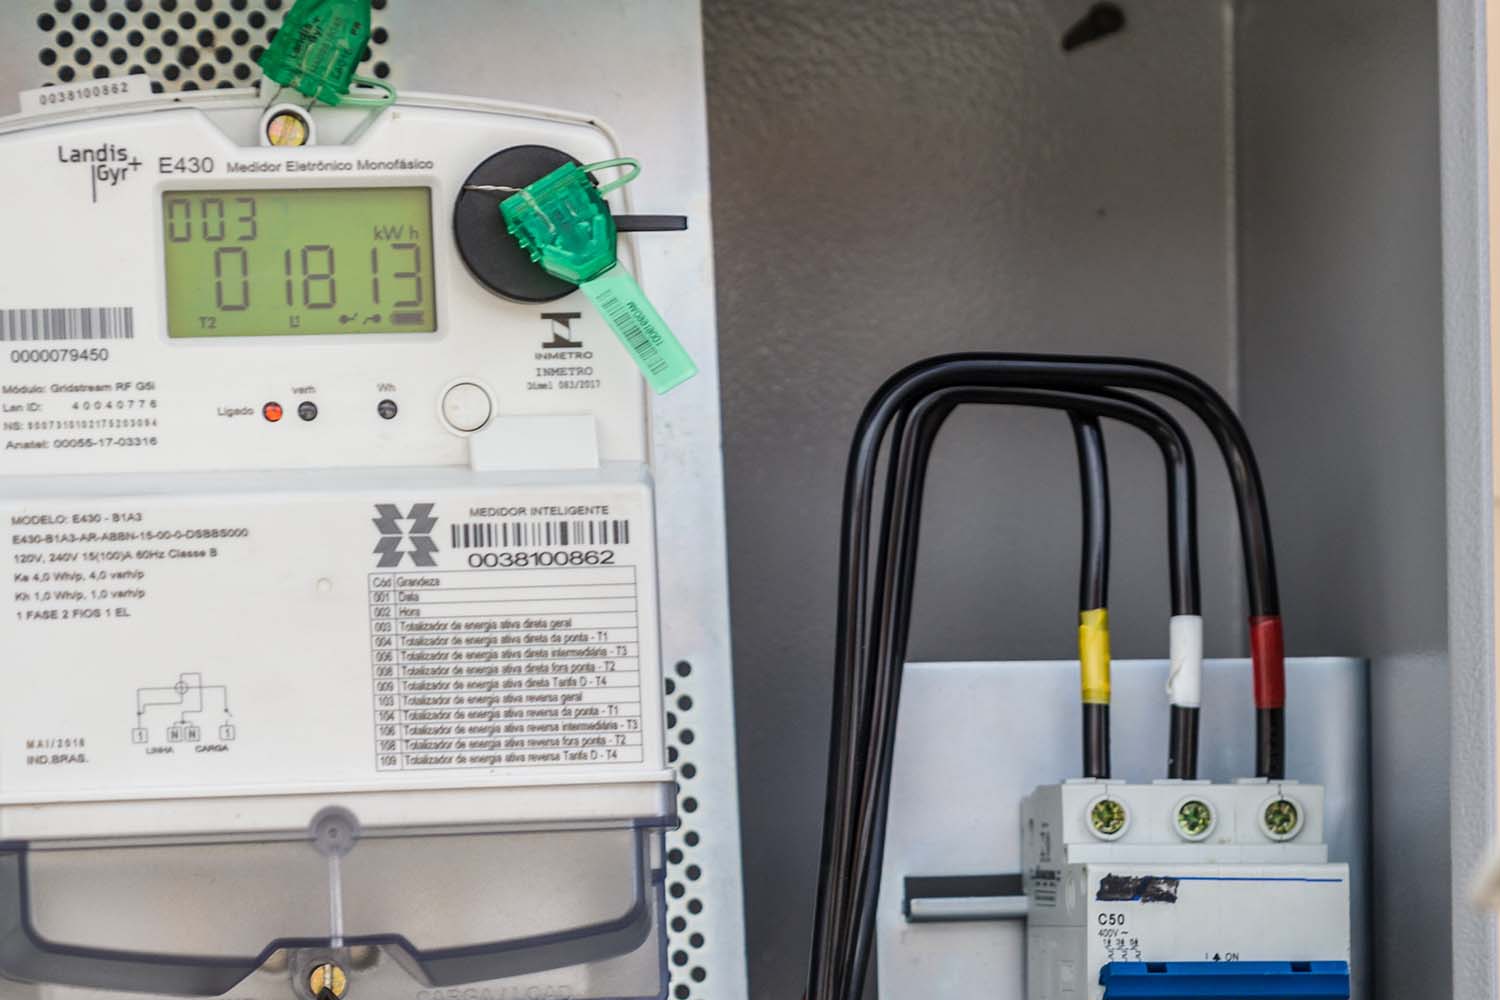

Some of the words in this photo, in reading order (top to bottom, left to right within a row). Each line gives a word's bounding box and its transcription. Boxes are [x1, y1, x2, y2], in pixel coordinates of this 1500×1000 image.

[40, 82, 129, 105] 0038100862
[58, 144, 128, 162] Landis
[159, 157, 214, 173] E430
[227, 161, 280, 173] Medidor
[286, 160, 352, 172] Eletrônico
[357, 159, 434, 171] Monofásico
[168, 197, 257, 242] 003
[214, 243, 422, 311] 01813
[11, 348, 109, 363] 0000079450
[534, 351, 593, 360] INMETRO
[536, 367, 593, 376] INMETRO
[116, 382, 131, 391] RF
[217, 406, 254, 418] Ligado
[469, 506, 526, 517] MEDIDOR
[531, 505, 609, 516] INTELIGENTE
[11, 515, 65, 525] MODELO:
[71, 514, 101, 523] E430
[111, 512, 142, 522] B1A3
[49, 552, 78, 562] 240V
[135, 549, 165, 559] 60Hz
[167, 547, 207, 558] Classe
[209, 547, 217, 557] B
[468, 551, 615, 568] 0038100862
[396, 575, 440, 587] Grandeza
[398, 590, 419, 601] Data
[26, 610, 58, 620] FASE
[62, 610, 68, 619] 2
[72, 609, 101, 619] FIOS
[115, 608, 130, 617] EL
[400, 620, 448, 632] Totalizador
[400, 635, 448, 647] Totalizador
[597, 631, 608, 641] T1
[401, 649, 449, 661] Totalizador
[402, 664, 449, 676] Totalizador
[603, 660, 616, 671] T2
[402, 679, 450, 691] Totalizador
[595, 674, 607, 685] T4
[403, 694, 451, 706] Totalizador
[403, 709, 451, 721] Totalizador
[607, 704, 618, 714] T1
[404, 724, 452, 736] Totalizador
[626, 718, 638, 729] T3
[405, 738, 452, 750] Totalizador
[614, 733, 626, 745] T2
[195, 745, 229, 753] CARGA
[405, 753, 453, 765] Totalizador
[605, 748, 617, 759] T4
[1098, 912, 1125, 926] C50
[1225, 952, 1240, 961] ON
